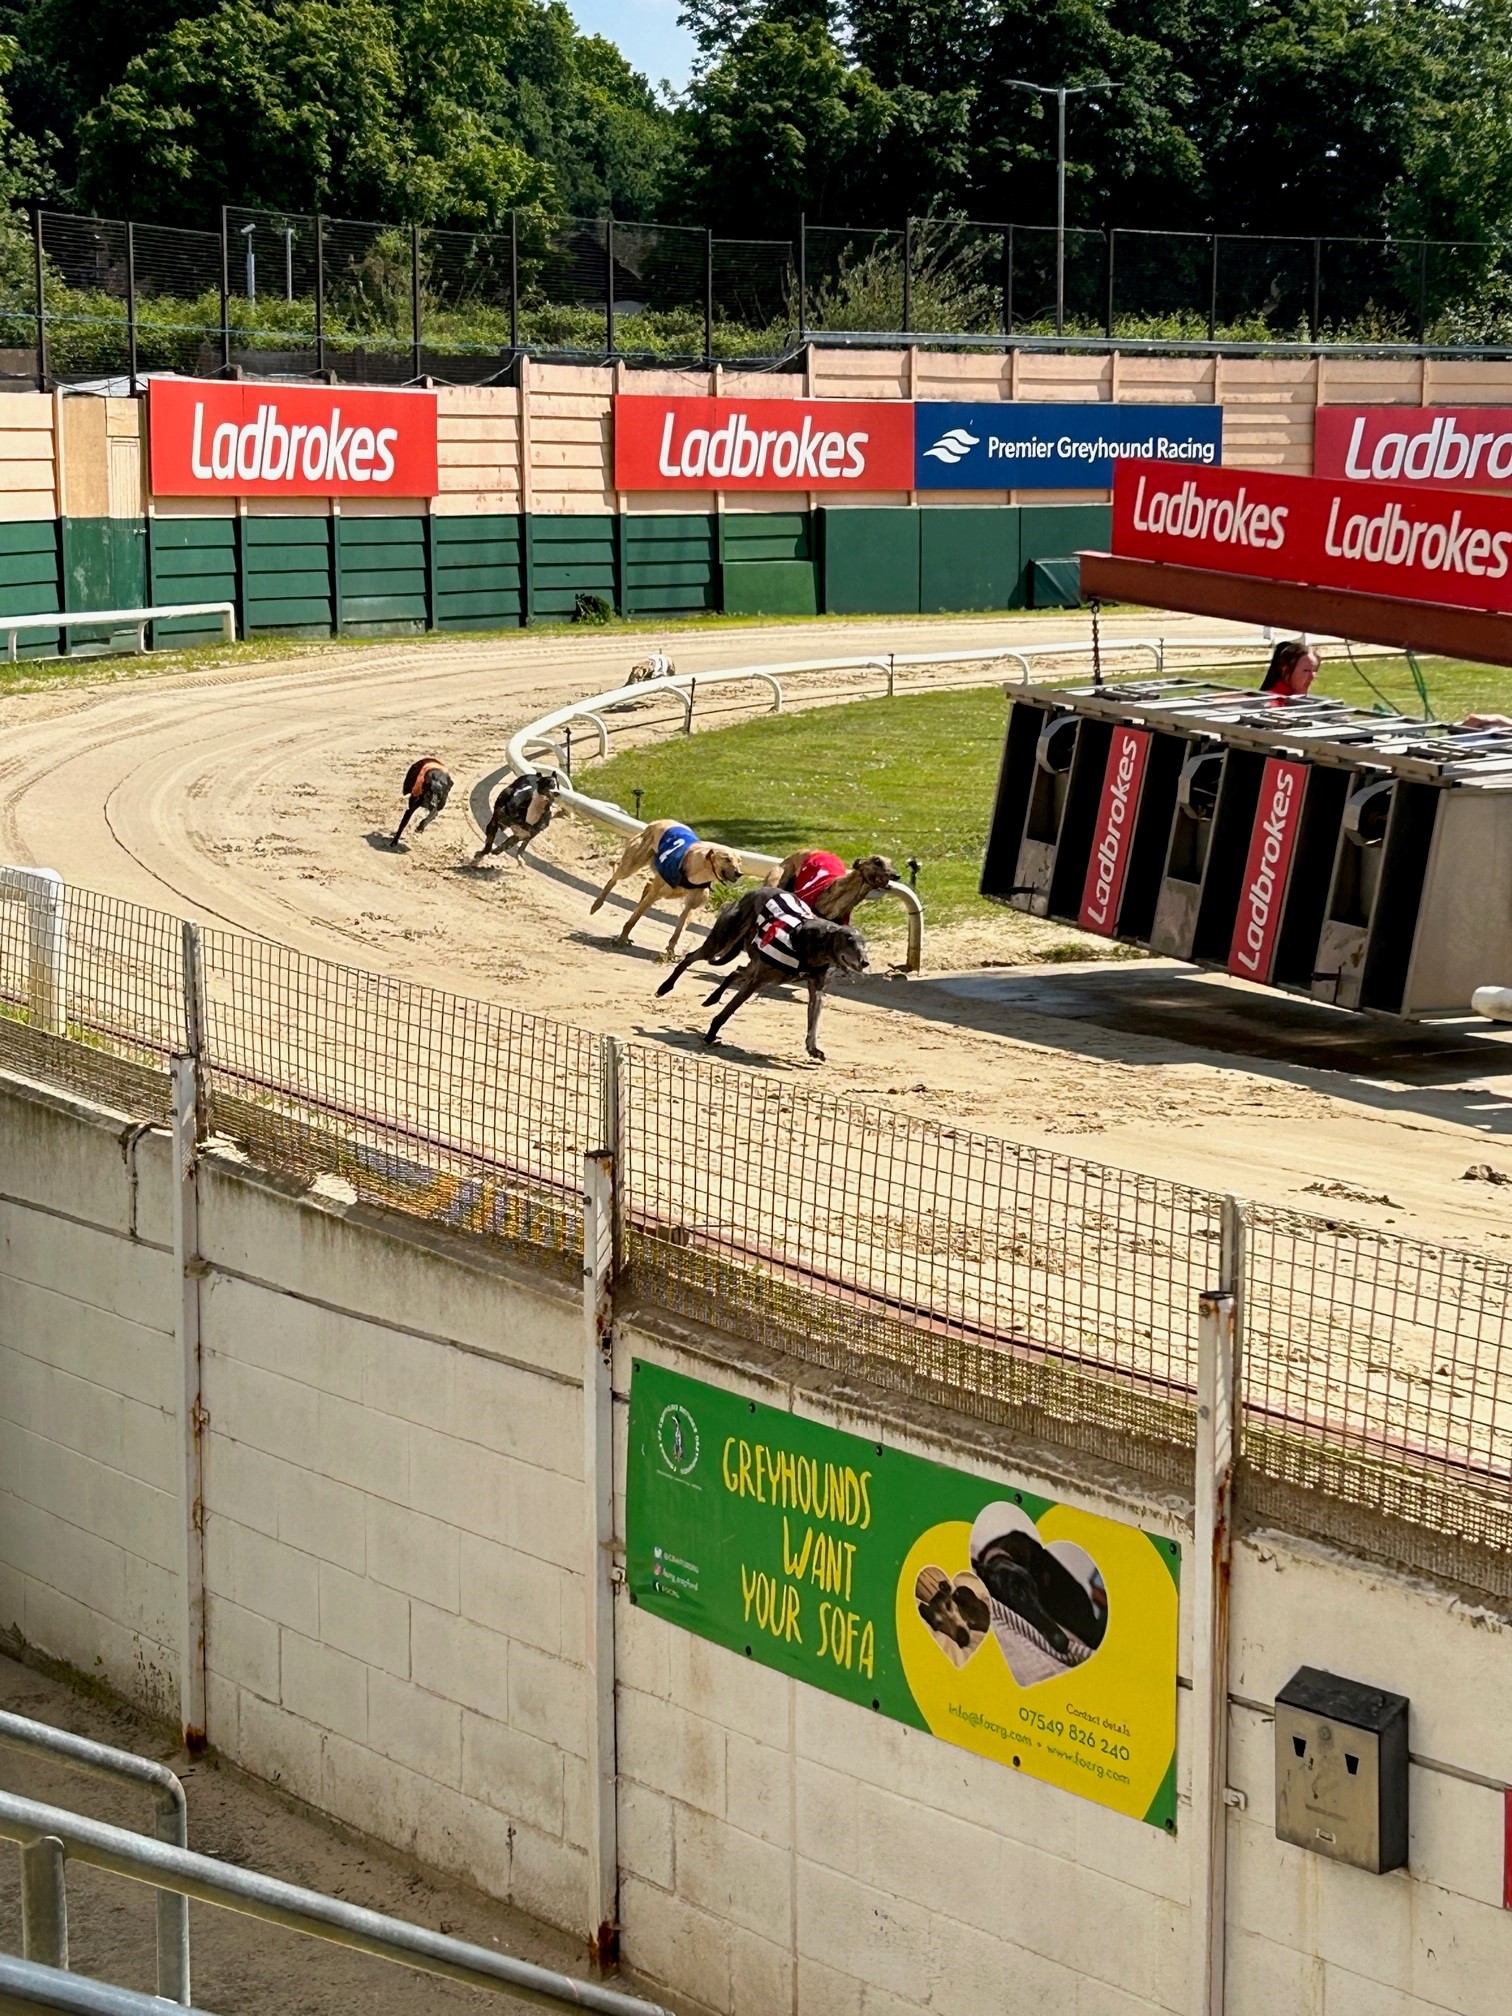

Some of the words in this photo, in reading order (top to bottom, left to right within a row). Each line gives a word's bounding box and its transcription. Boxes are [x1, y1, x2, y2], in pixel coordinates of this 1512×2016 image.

[192, 402, 398, 482] Ladbrokes
[659, 412, 869, 478] Ladbrokes
[988, 436, 1054, 459] Premier
[1057, 436, 1153, 463] Greyhound
[1157, 437, 1215, 464] Racing
[1133, 475, 1289, 550] Ladbrokes
[1325, 496, 1512, 579] Ladbrokes
[1087, 736, 1137, 925] Ladbrokes
[1238, 769, 1293, 971] Ladbrokes
[722, 1437, 872, 1529] GREYHOUNDS
[783, 1515, 856, 1601] WANT
[741, 1563, 802, 1644] YOUR
[816, 1602, 874, 1679] SOFA
[1018, 1707, 1064, 1737] 07549
[1069, 1724, 1096, 1748] 826
[1101, 1738, 1131, 1761] 240
